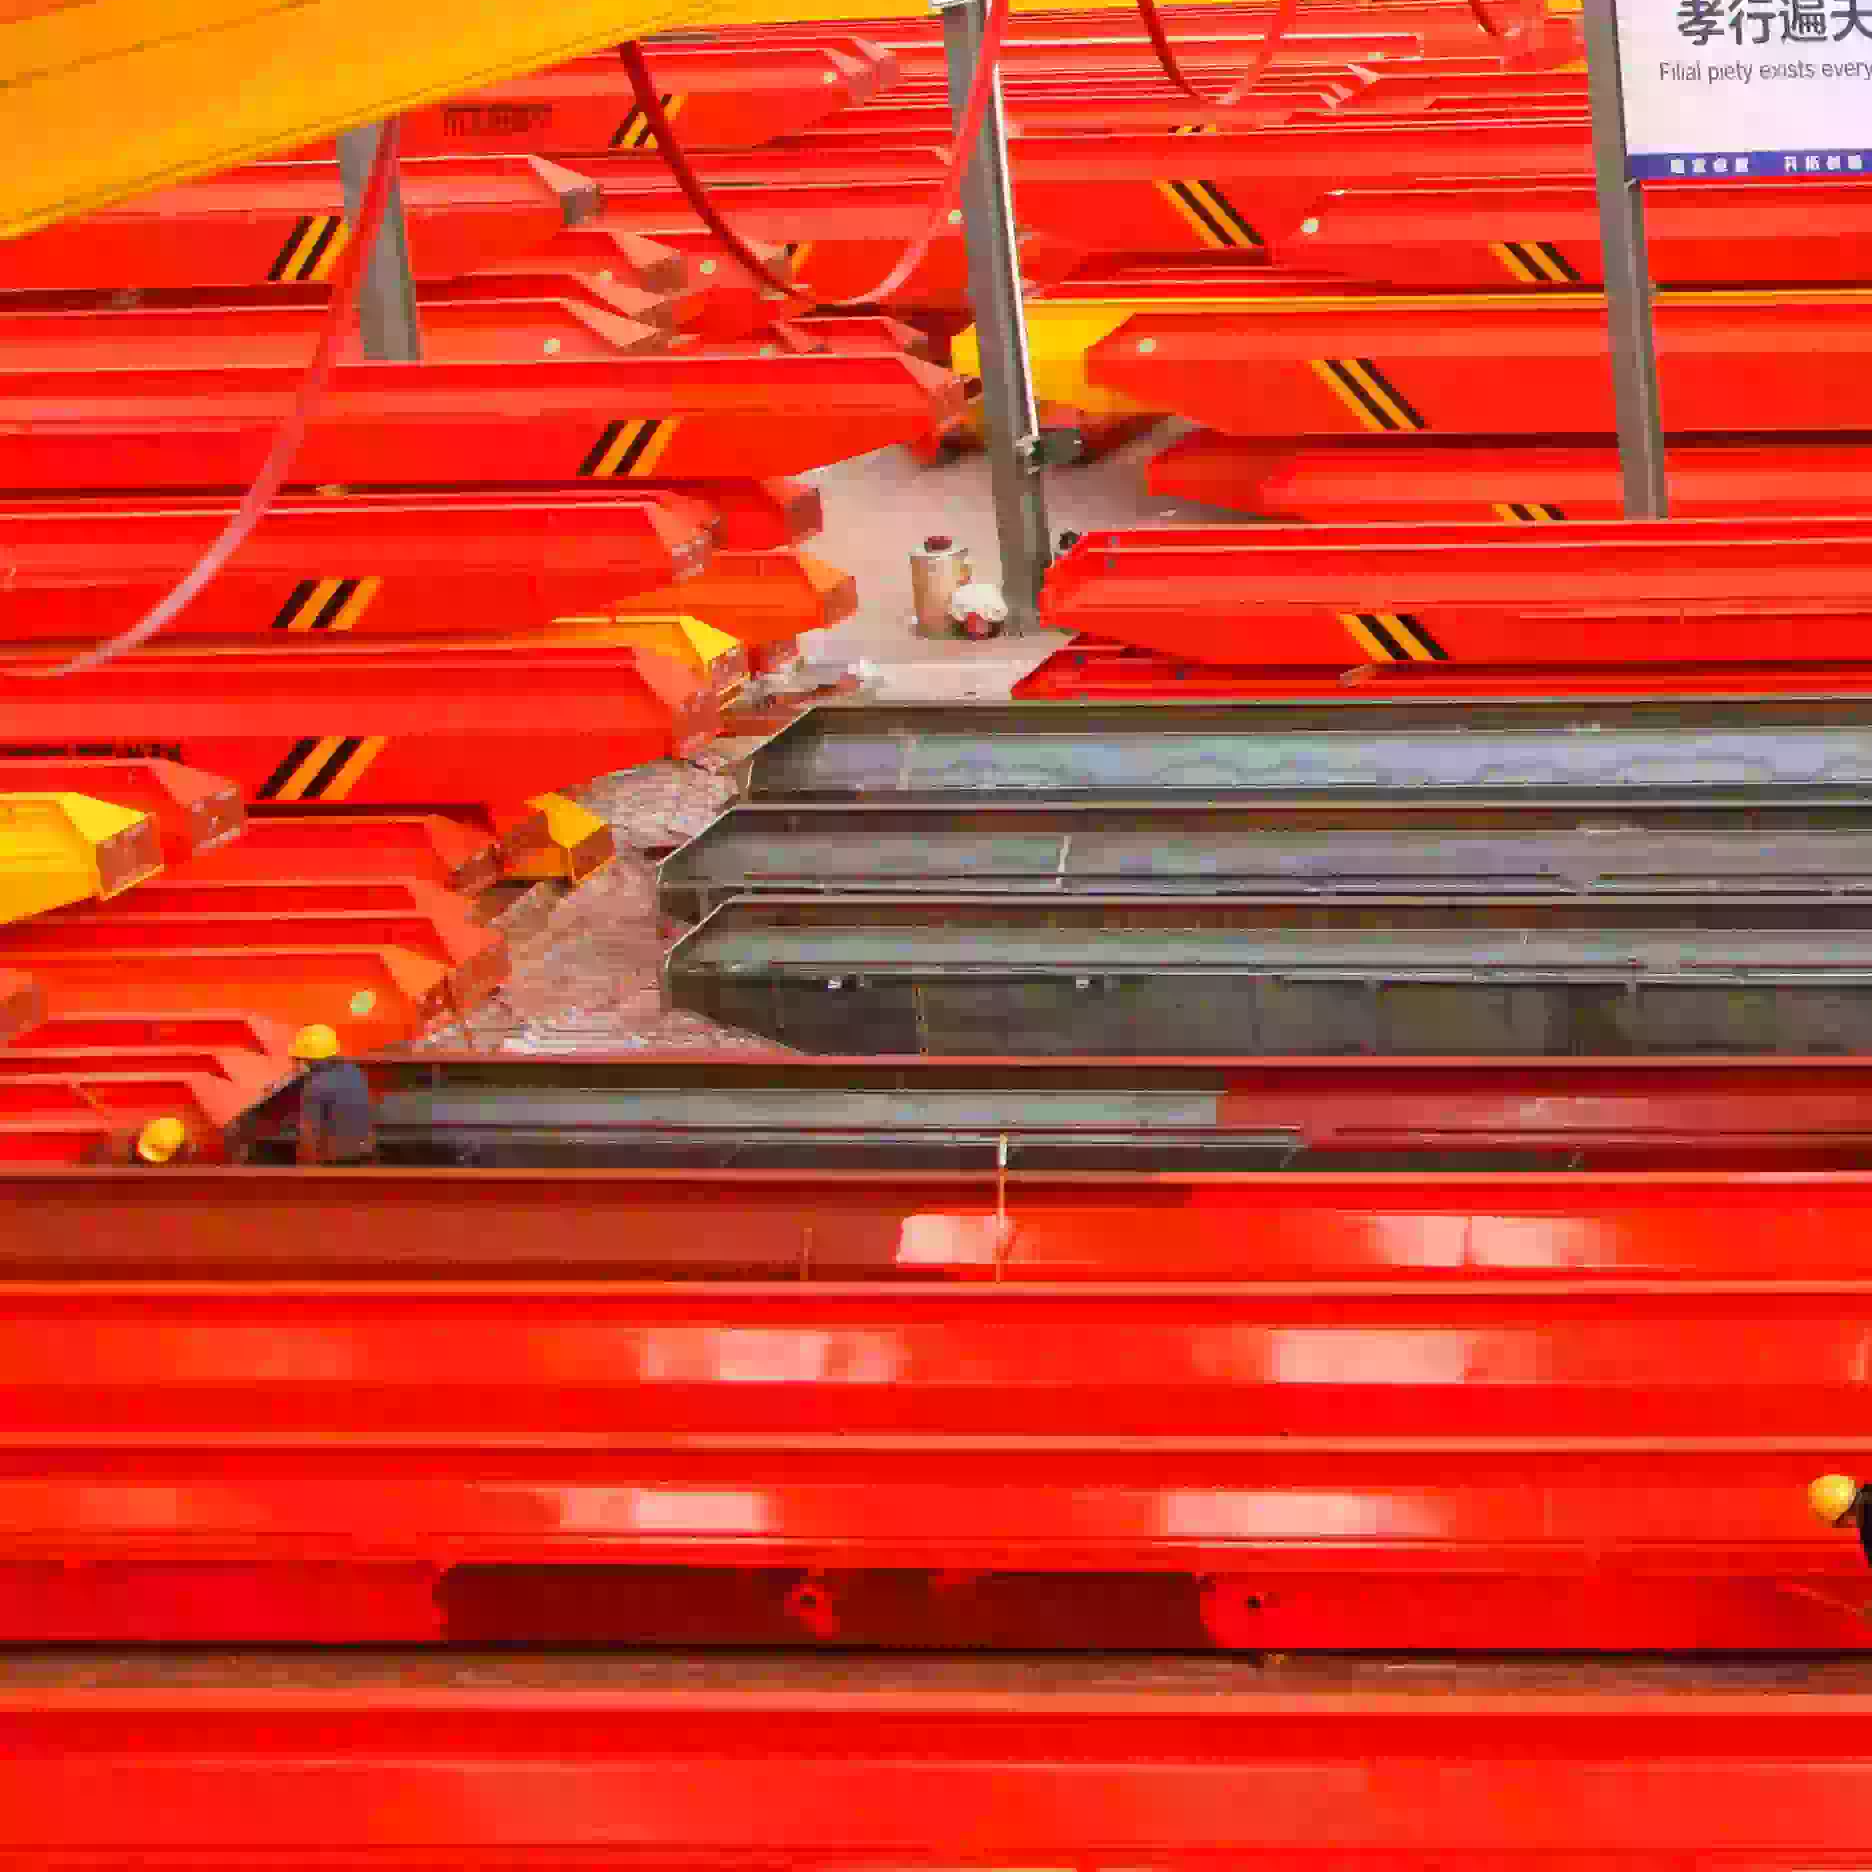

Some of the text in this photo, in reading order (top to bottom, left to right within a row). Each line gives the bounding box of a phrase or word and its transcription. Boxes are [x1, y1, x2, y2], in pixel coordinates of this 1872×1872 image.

[1659, 59, 1701, 82] Filial
[1708, 61, 1753, 85] piety
[1759, 58, 1817, 80] exists
